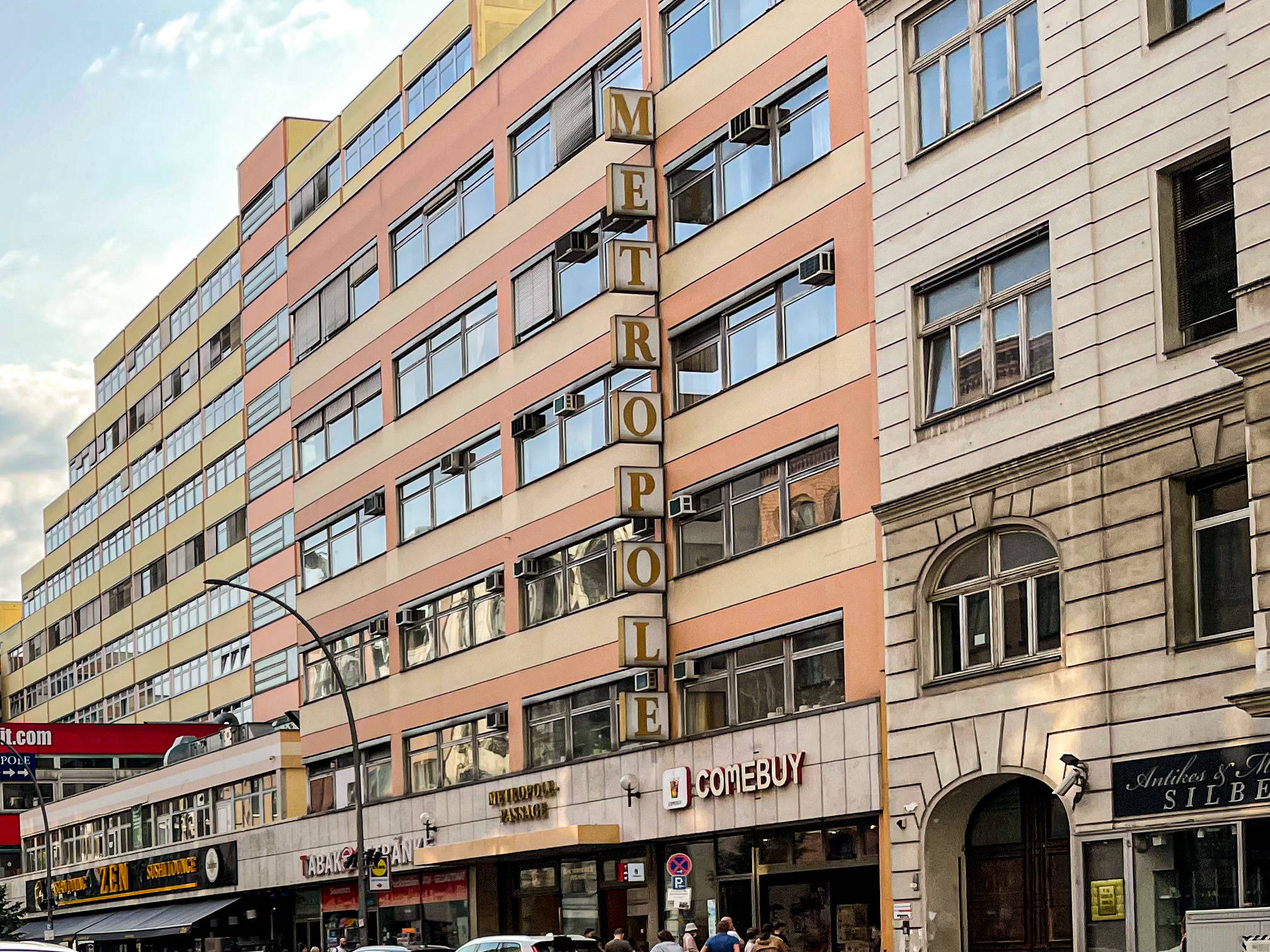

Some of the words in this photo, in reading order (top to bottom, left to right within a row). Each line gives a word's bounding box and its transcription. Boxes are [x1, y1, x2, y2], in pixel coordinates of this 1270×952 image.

[612, 93, 662, 737] METROPOLE
[696, 752, 805, 799] COMEBUY
[1126, 754, 1207, 790] Antikes
[99, 862, 129, 894] ZEN
[299, 850, 343, 878] TABAK
